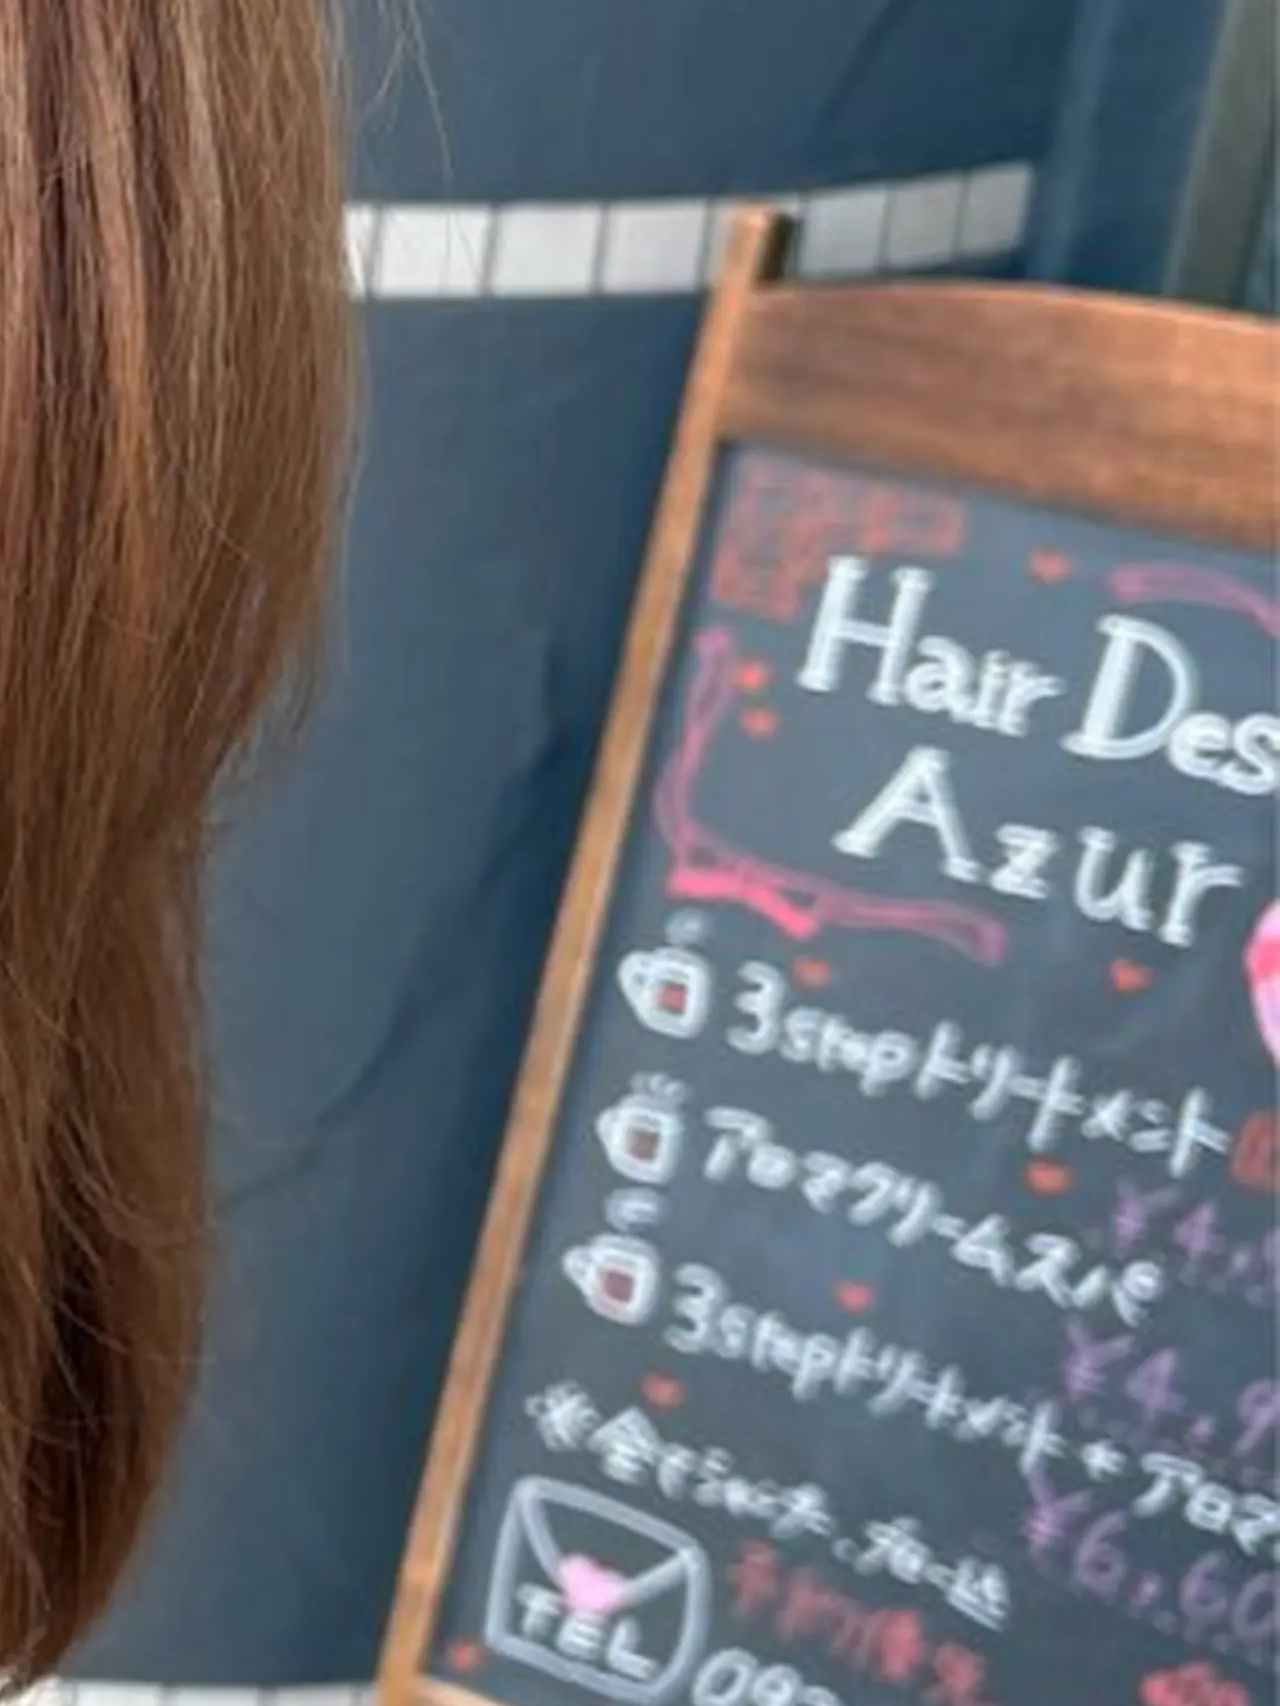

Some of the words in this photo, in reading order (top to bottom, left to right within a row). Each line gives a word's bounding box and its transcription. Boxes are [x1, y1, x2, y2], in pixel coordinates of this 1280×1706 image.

[796, 554, 1067, 737] Hair
[1059, 614, 1280, 796] Des
[831, 744, 1244, 948] Azur
[514, 1582, 658, 1683] TEL
